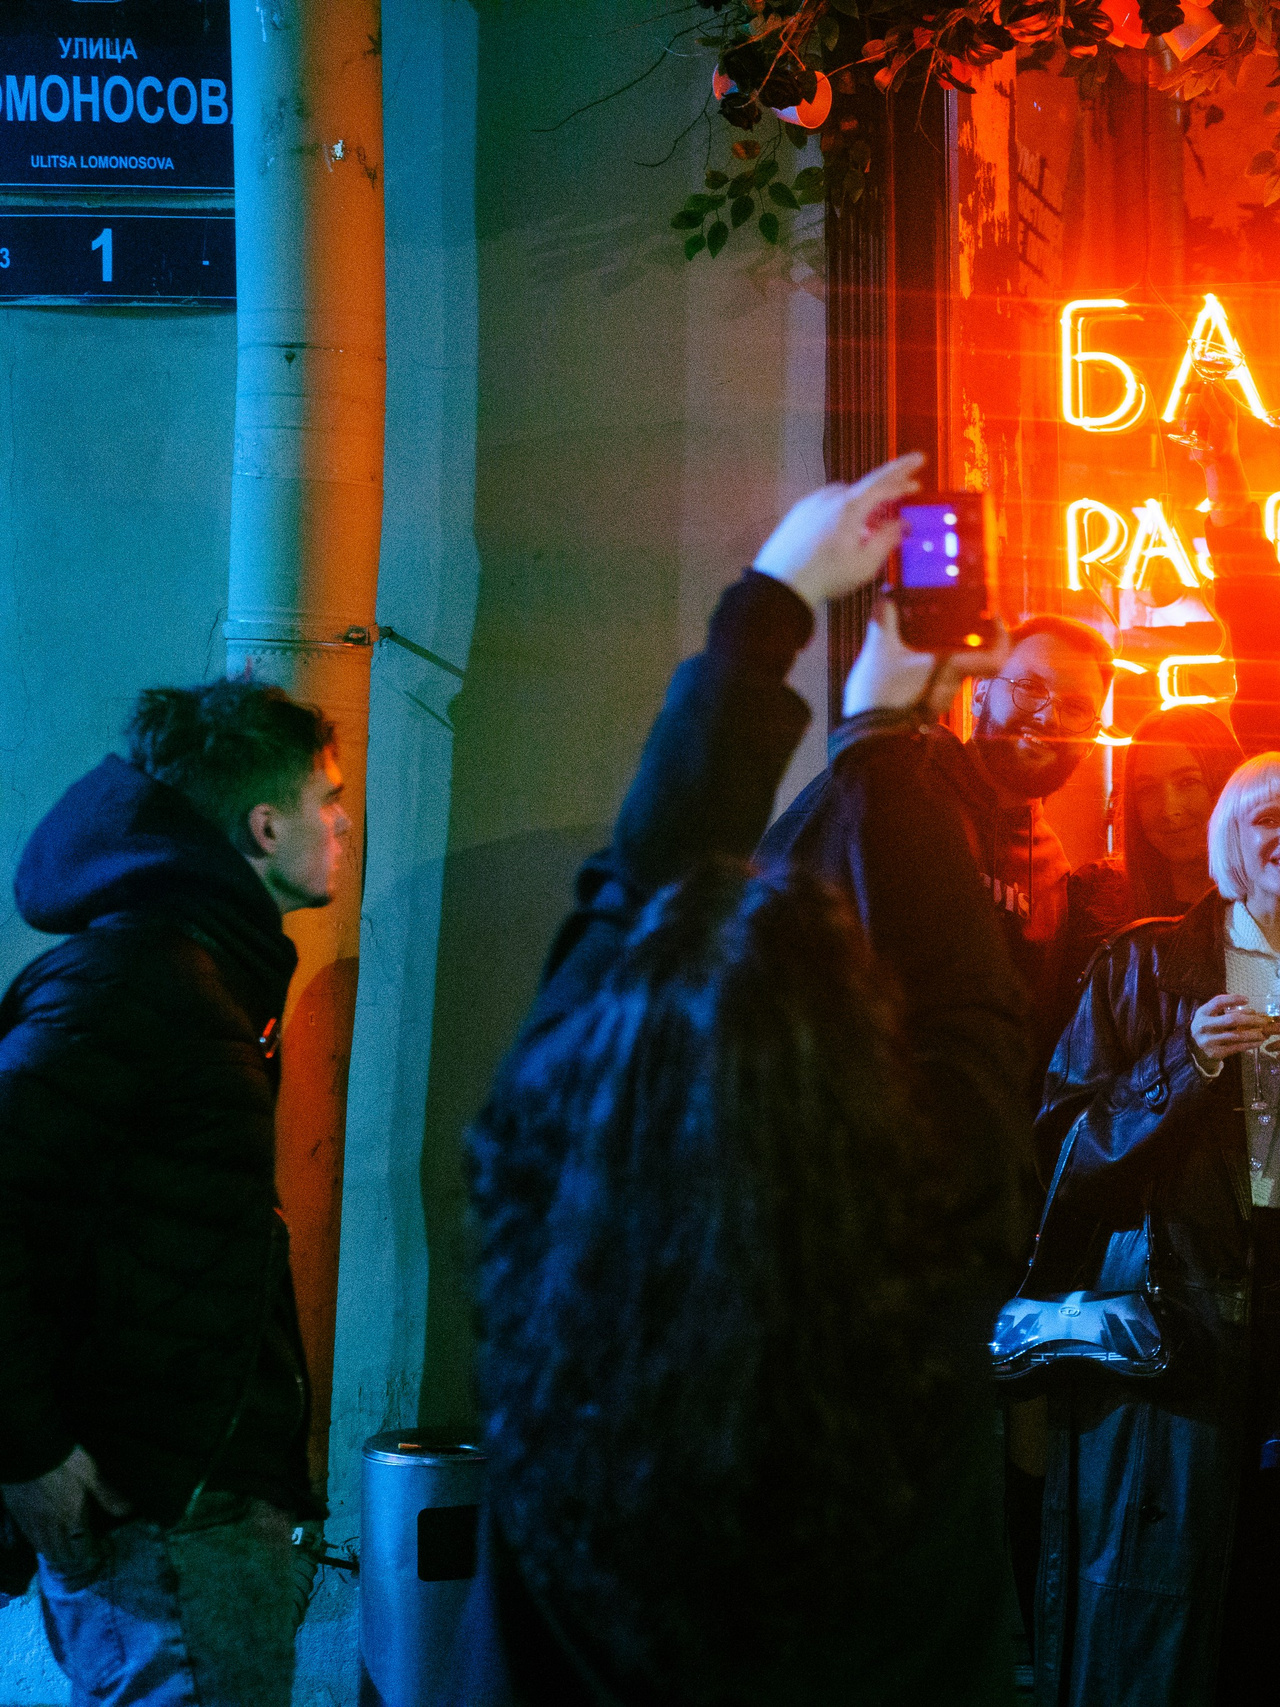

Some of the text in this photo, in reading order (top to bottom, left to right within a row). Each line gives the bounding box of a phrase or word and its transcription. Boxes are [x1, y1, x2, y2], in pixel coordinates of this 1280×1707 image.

[58, 37, 138, 63] УЛИЦА
[0, 75, 233, 125] МОНОСОВ
[31, 155, 175, 171] ULITSA LOMONOSOVA
[91, 228, 113, 282] 1
